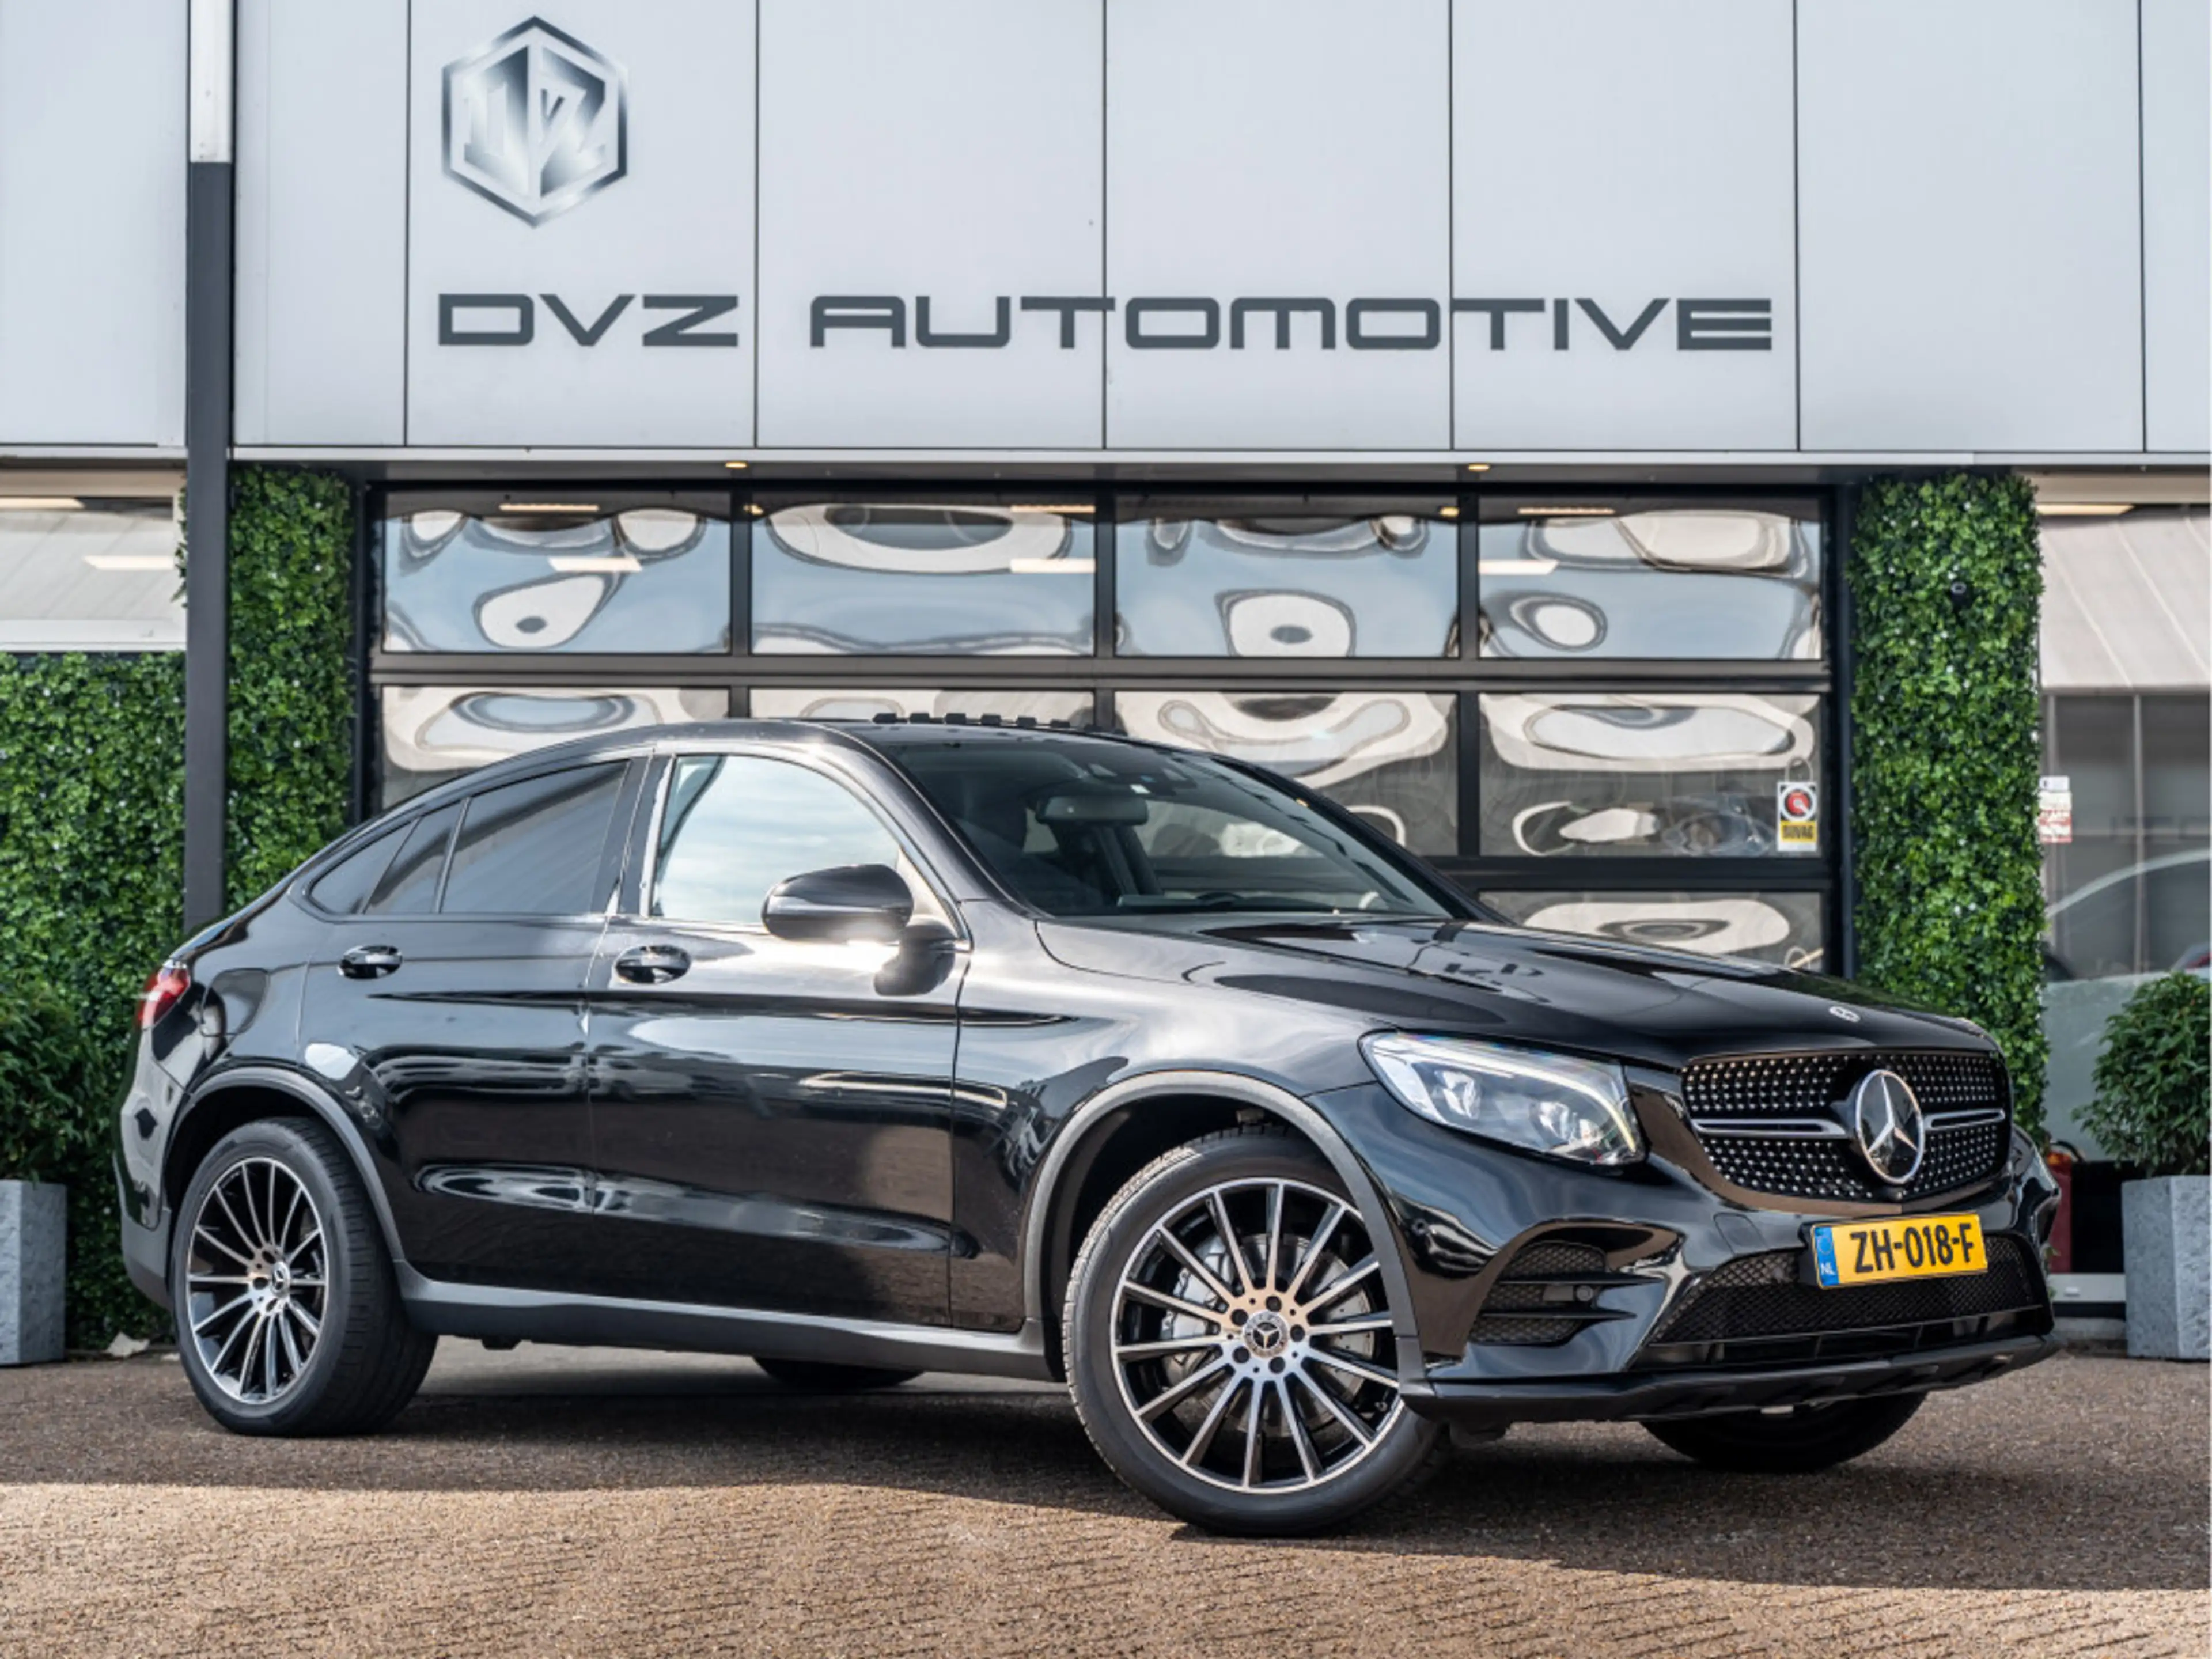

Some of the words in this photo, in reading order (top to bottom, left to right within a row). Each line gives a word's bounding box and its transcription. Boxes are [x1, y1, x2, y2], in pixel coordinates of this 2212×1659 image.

[438, 294, 738, 347] DVZ
[810, 295, 1772, 350] AUTOMOTIVE
[1820, 1262, 1836, 1275] NL
[1850, 1222, 1974, 1273] ZH-018-F
